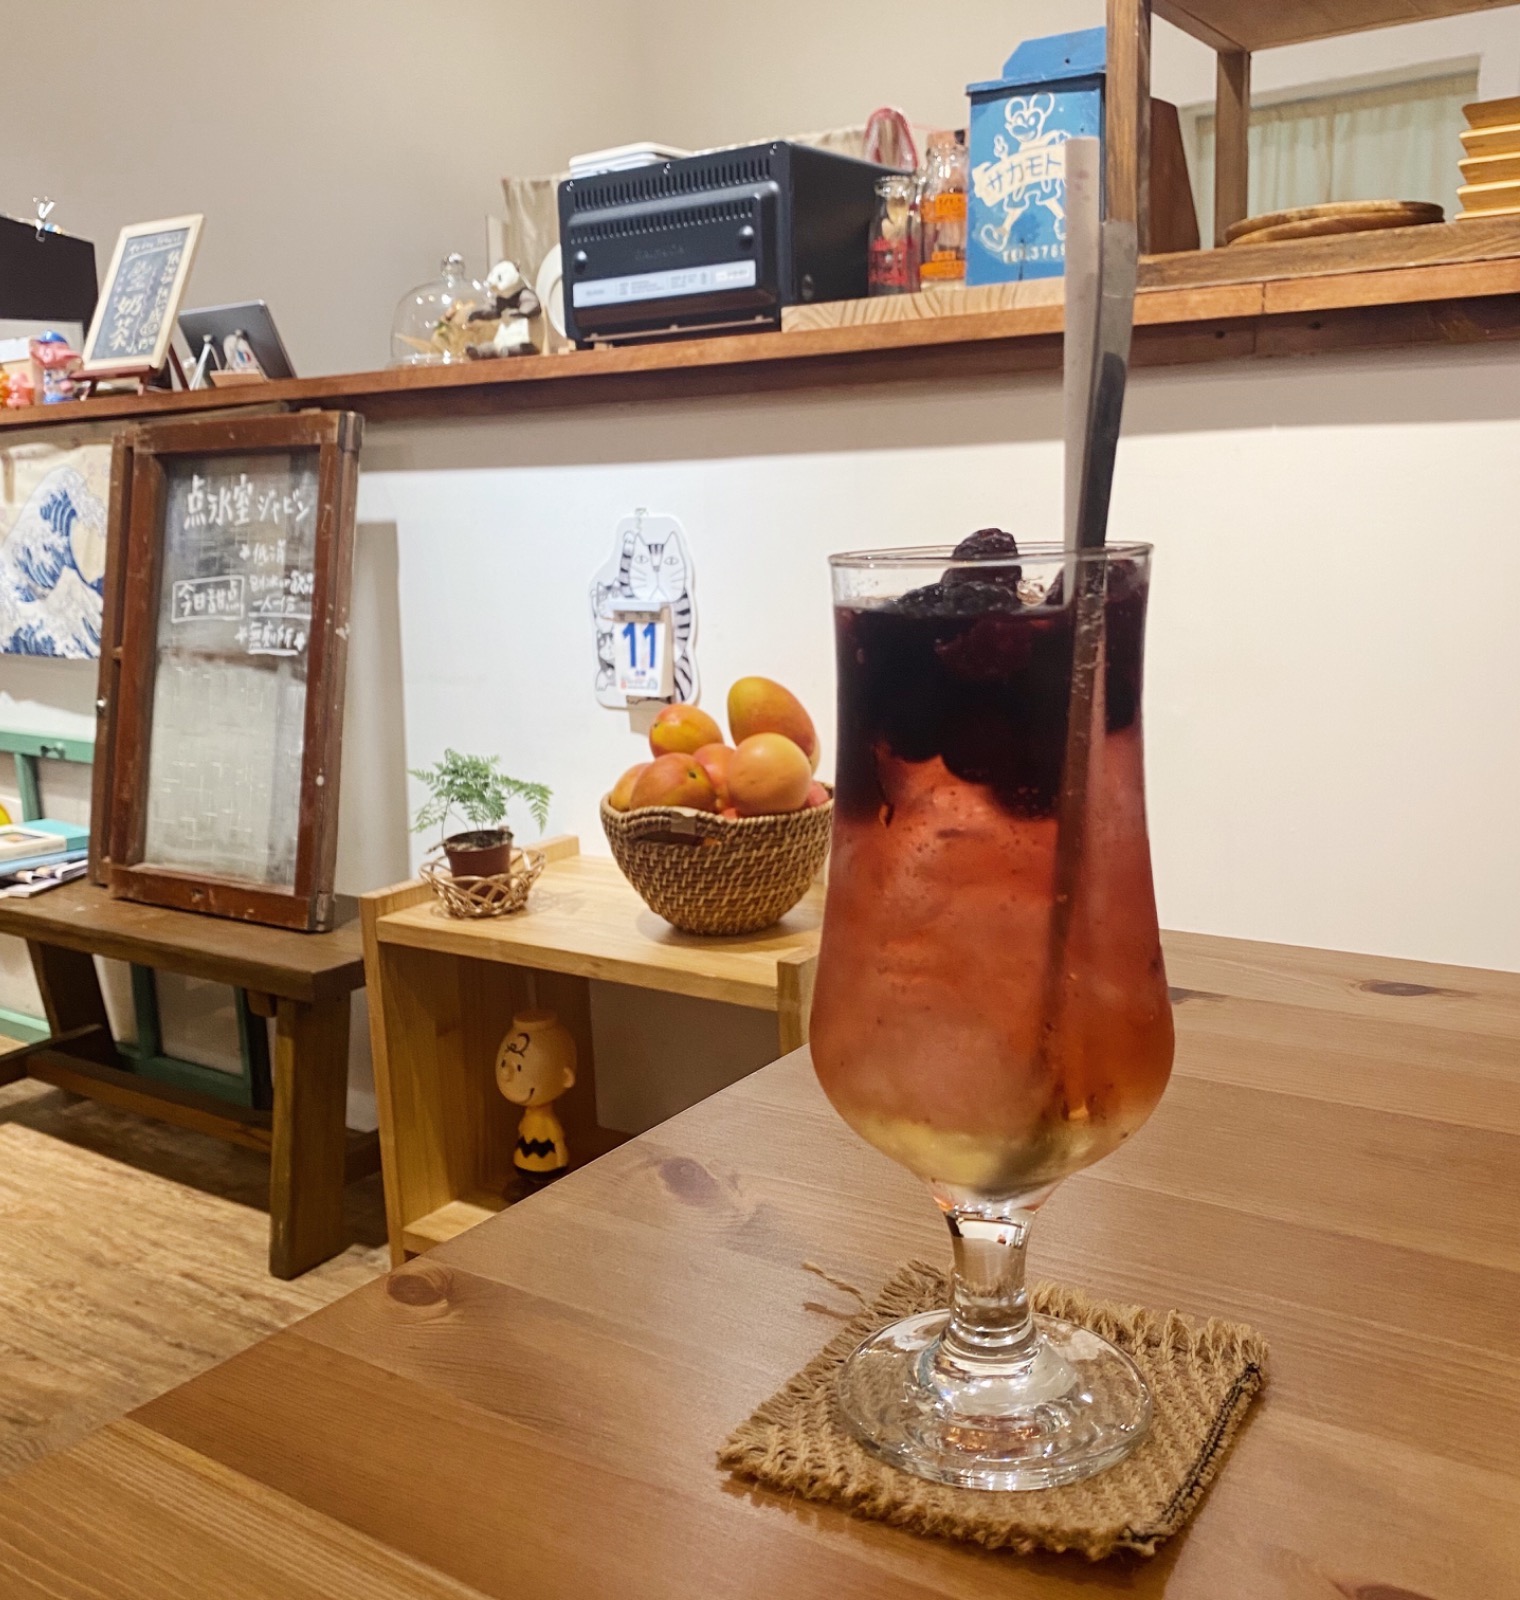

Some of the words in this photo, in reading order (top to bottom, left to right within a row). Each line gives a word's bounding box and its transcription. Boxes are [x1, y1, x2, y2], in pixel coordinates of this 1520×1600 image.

[987, 153, 1062, 193] サカモト
[622, 622, 656, 669] 11
